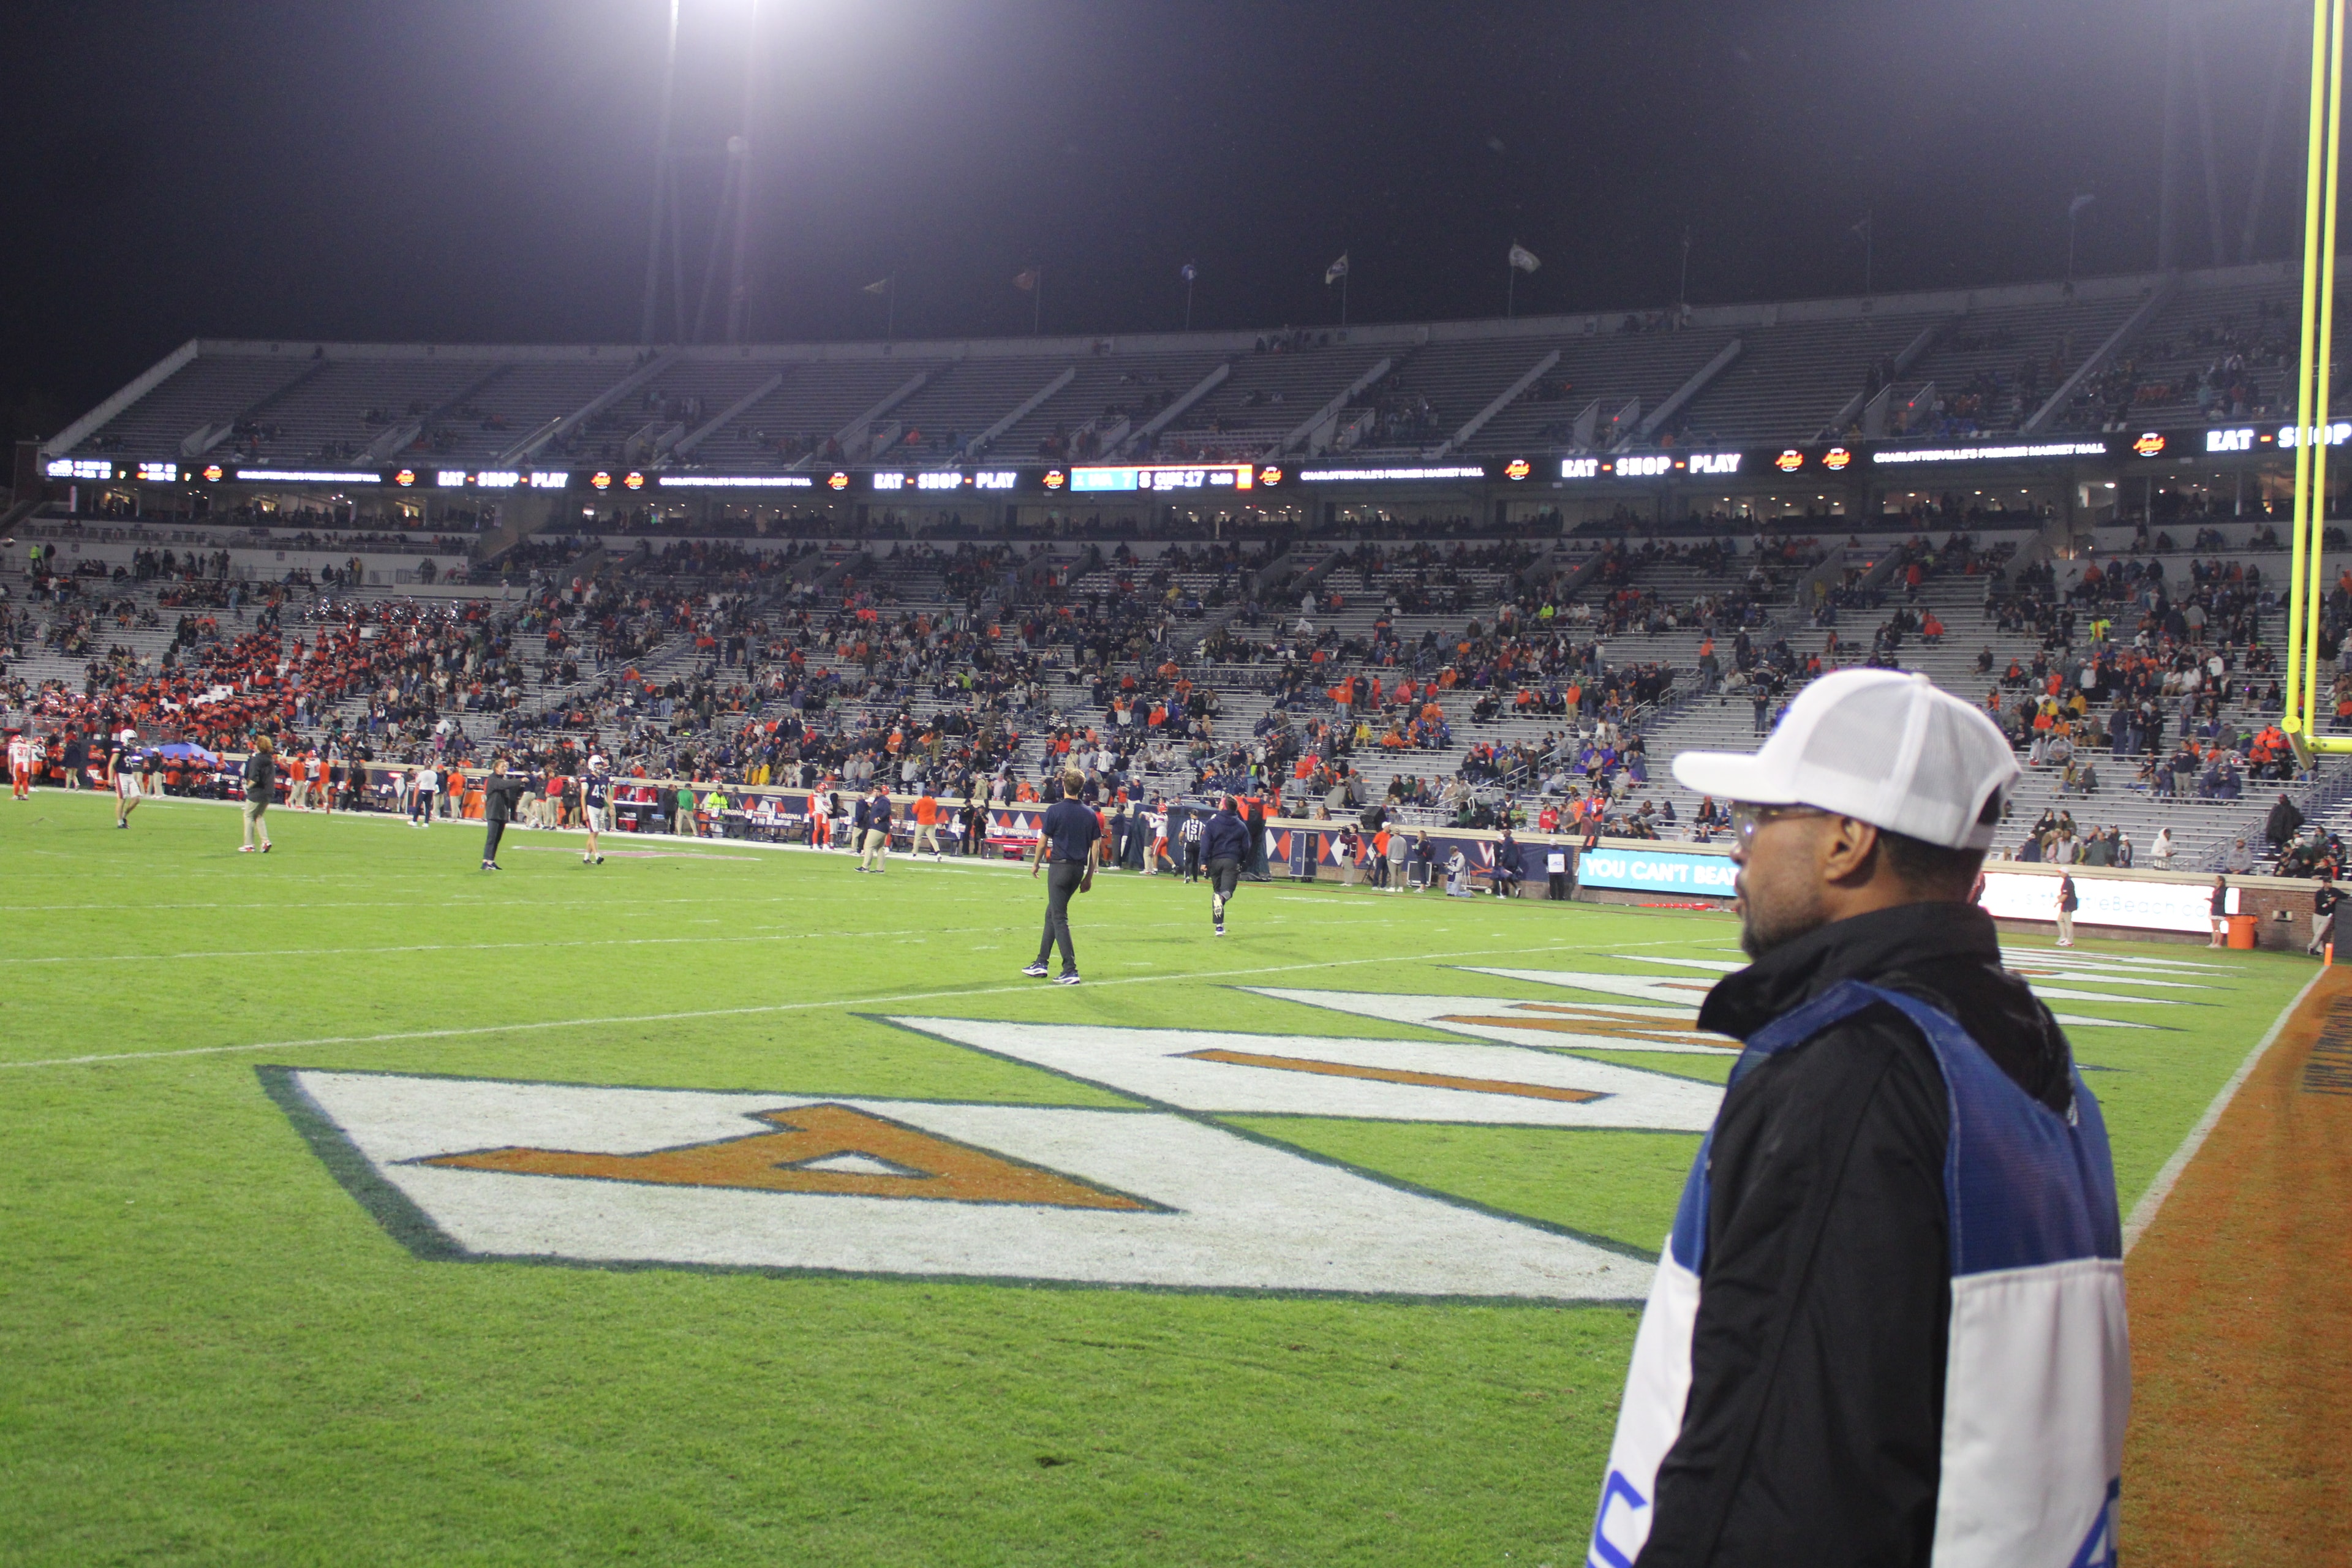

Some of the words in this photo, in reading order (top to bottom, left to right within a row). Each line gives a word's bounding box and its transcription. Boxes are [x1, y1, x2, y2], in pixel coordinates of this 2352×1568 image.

[2206, 429, 2254, 451] EAT
[1561, 459, 1598, 478] EAT
[1615, 457, 1671, 476] SHOP
[1689, 454, 1741, 473] PLAY
[437, 472, 466, 486] EAT
[477, 472, 519, 487] SHOP
[531, 472, 568, 488] PLAY
[874, 473, 903, 489] EAT
[918, 473, 962, 488] SHOP
[976, 473, 1017, 488] PLAY
[1122, 472, 1133, 488] 7
[1185, 471, 1205, 487] 17
[17, 745, 28, 756] 37
[590, 784, 607, 801] 43
[1189, 824, 1197, 835] S
[1585, 858, 1626, 878] YOU
[1630, 861, 1689, 883] CAN'T
[1694, 865, 1741, 886] BEAT
